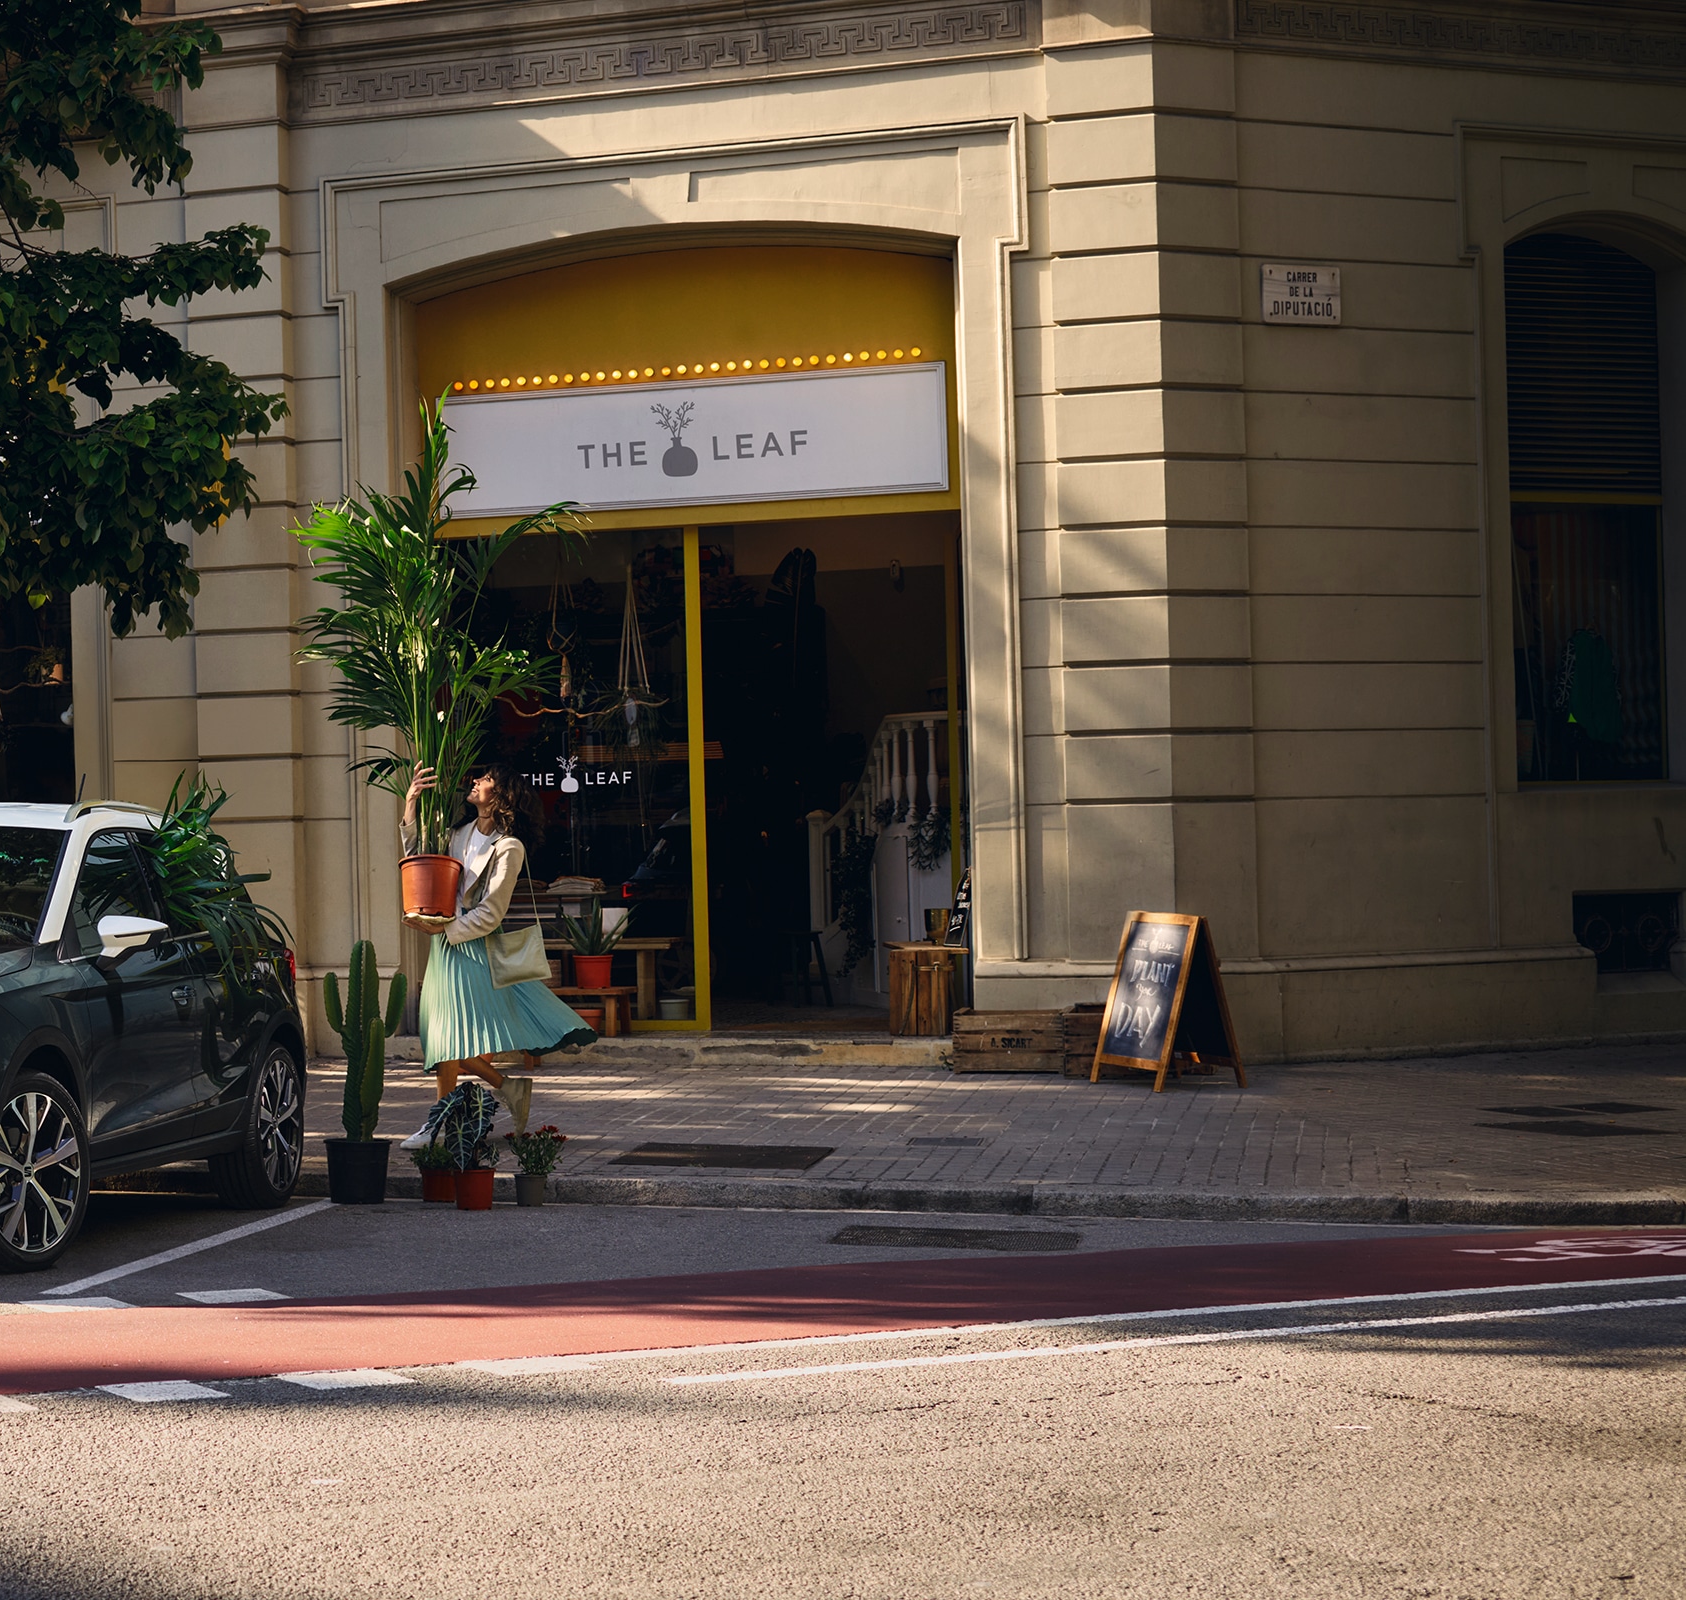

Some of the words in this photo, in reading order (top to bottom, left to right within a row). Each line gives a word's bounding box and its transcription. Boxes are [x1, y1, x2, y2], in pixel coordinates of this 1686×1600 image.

[1287, 272, 1317, 283] CARRER
[1290, 286, 1299, 297] DE
[1303, 287, 1313, 297] LA
[1273, 297, 1332, 317] DIPUTACIÓ
[577, 440, 648, 469] THE
[712, 429, 809, 461] LEAF
[585, 770, 634, 786] LEAF
[1130, 959, 1176, 987] PLANT
[1115, 1002, 1160, 1048] DAY
[1001, 1037, 1033, 1049] SICART
